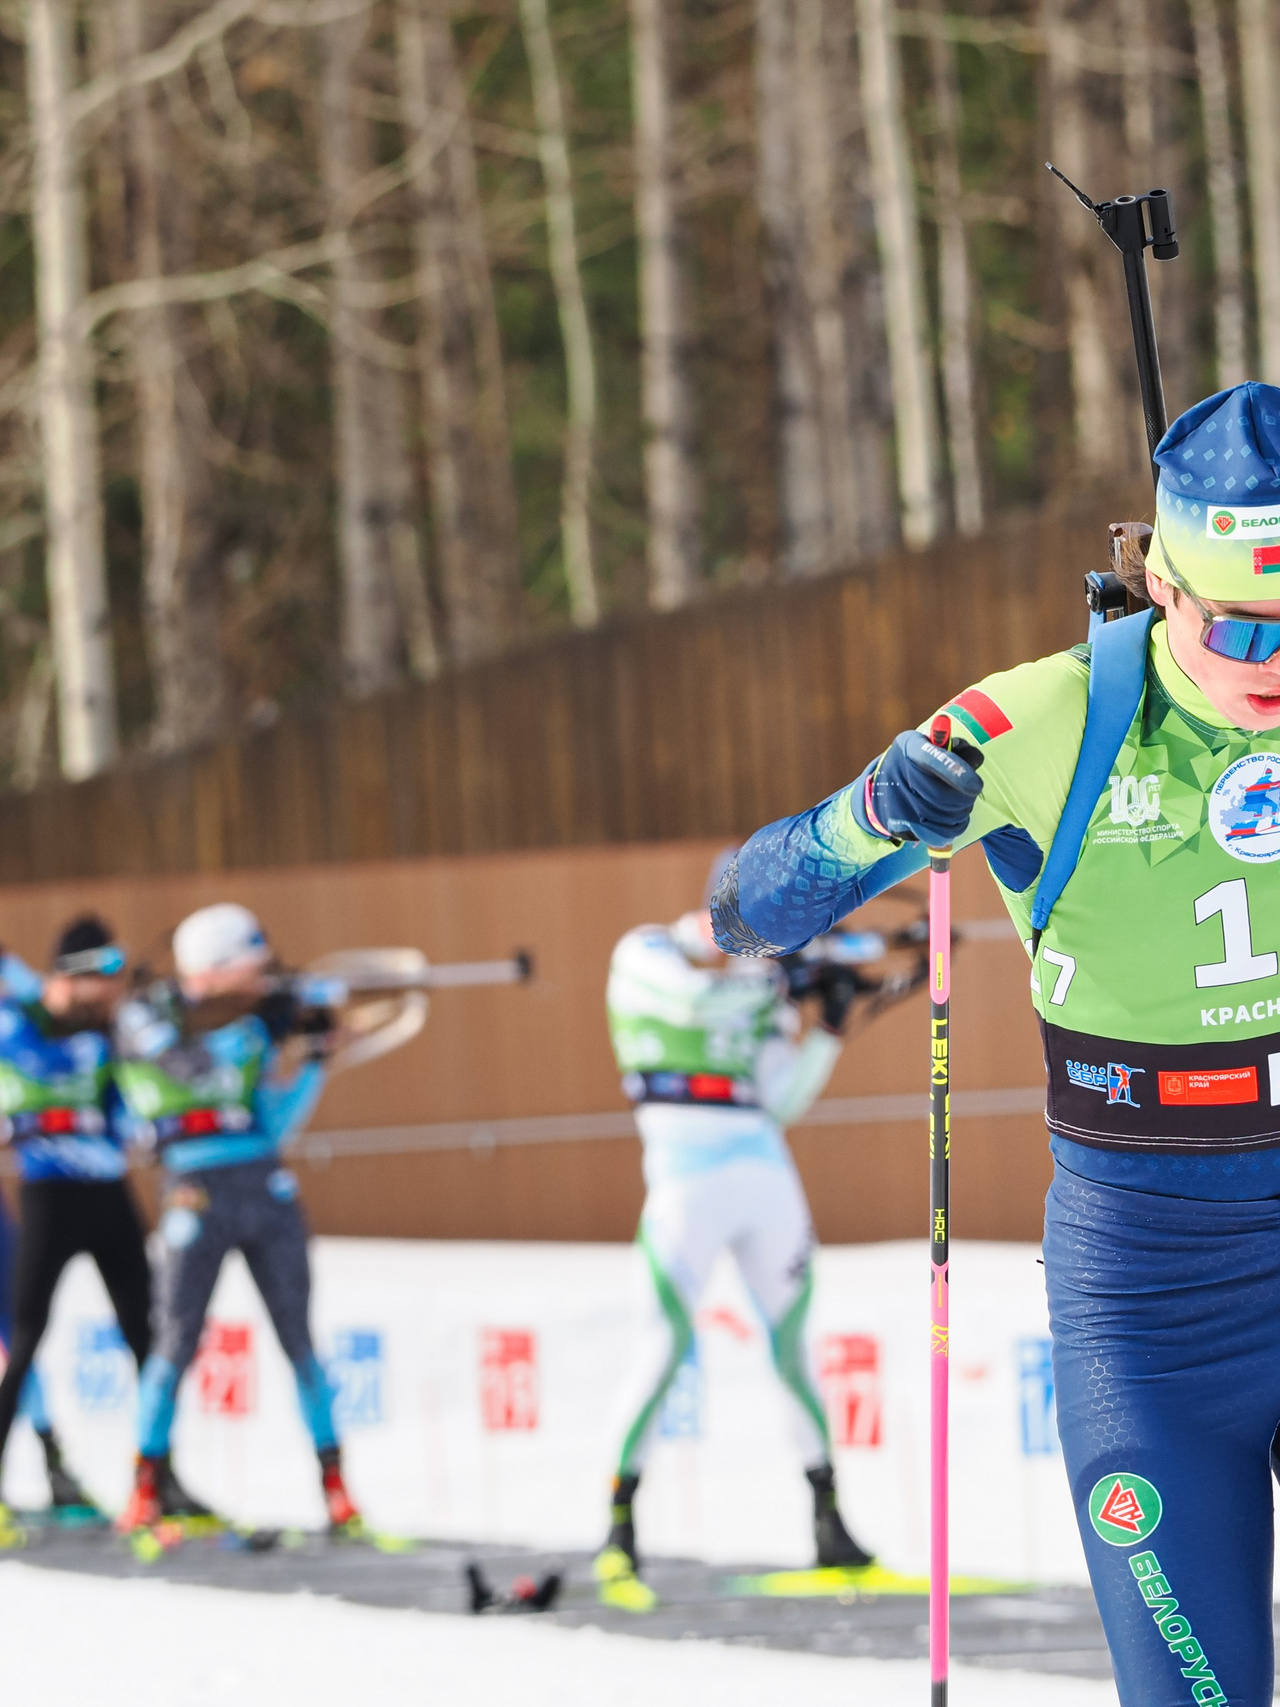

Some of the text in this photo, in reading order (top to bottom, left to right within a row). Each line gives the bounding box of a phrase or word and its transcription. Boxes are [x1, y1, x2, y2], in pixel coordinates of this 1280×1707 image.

[1215, 755, 1265, 795] ПЕРВЕНСТВО
[1092, 830, 1184, 846] РОССИЙСКОЙ ФЕДЕРАЦИИ
[1097, 823, 1180, 837] МИНИСТЕРСТВО СПОРТА
[931, 1018, 948, 1086] LEKI
[1067, 1066, 1108, 1086] СБР
[1188, 1071, 1251, 1082] КРАСНОЯРСКИЙ
[1189, 1080, 1210, 1088] КРАЙ
[934, 1208, 946, 1241] HRC
